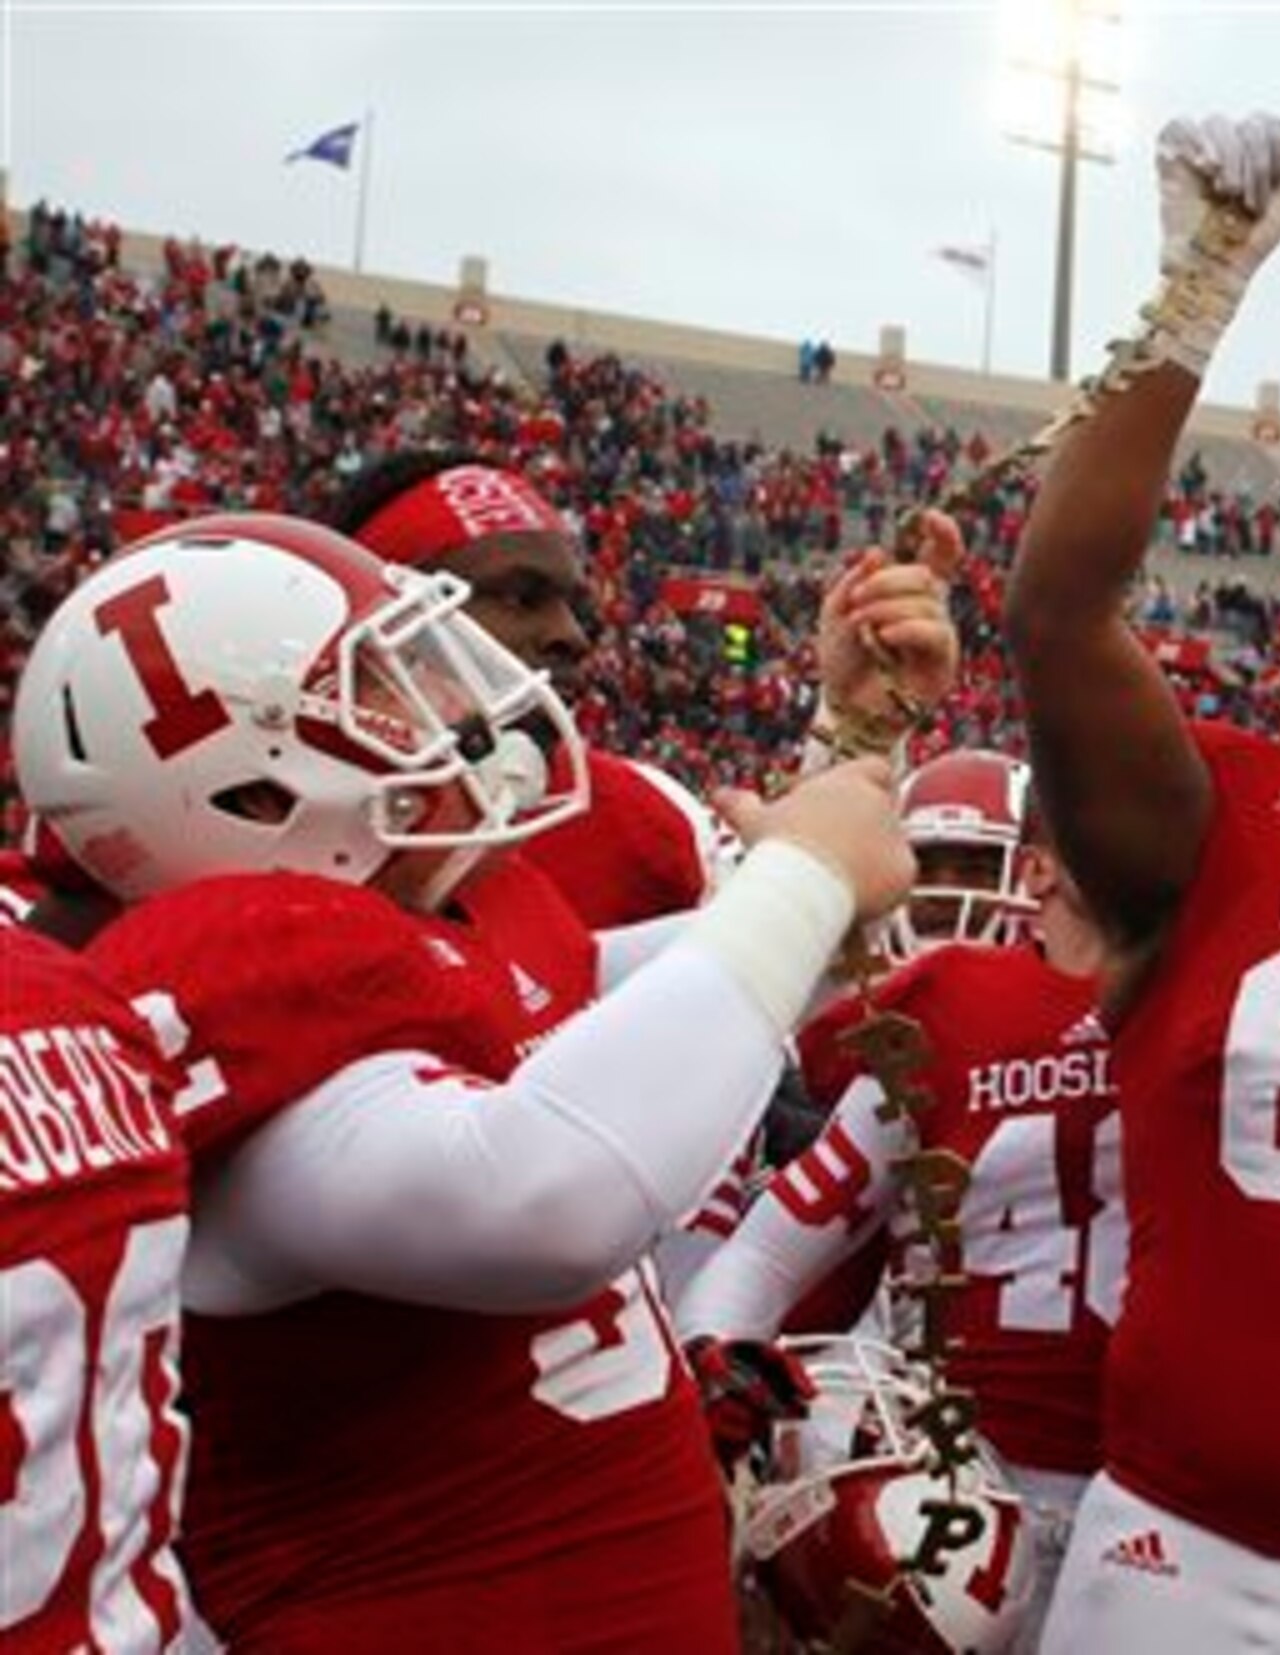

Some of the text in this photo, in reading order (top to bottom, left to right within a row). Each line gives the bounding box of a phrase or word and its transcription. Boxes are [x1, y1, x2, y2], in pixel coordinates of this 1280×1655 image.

[94, 575, 231, 760] I
[0, 1024, 171, 1190] OBERTS
[969, 1050, 1119, 1111] HOOSI
